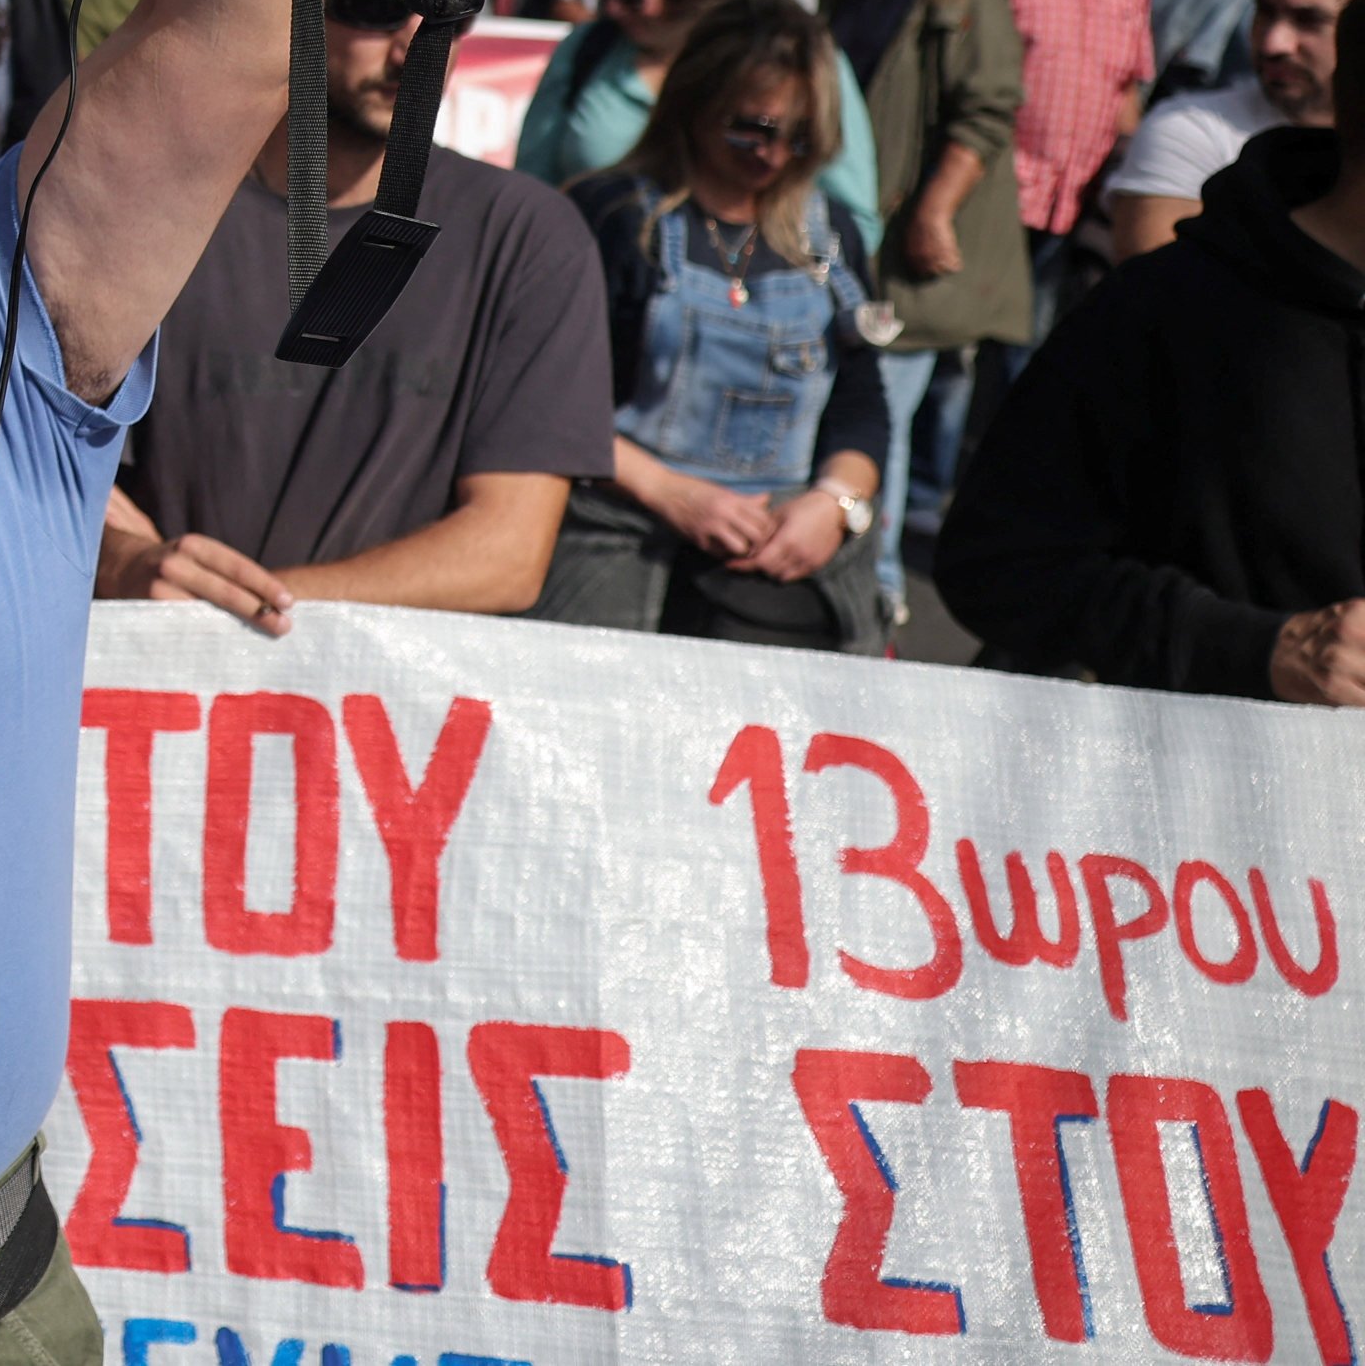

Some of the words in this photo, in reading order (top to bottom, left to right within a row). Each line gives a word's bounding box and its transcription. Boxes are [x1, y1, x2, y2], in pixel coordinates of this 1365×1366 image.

[80, 687, 493, 962] ΤΟΥ
[708, 724, 1339, 1022] 13ωρου
[64, 998, 634, 1314] ΣΕΙΣ
[792, 1047, 1359, 1366] ΣΤΟΥ
